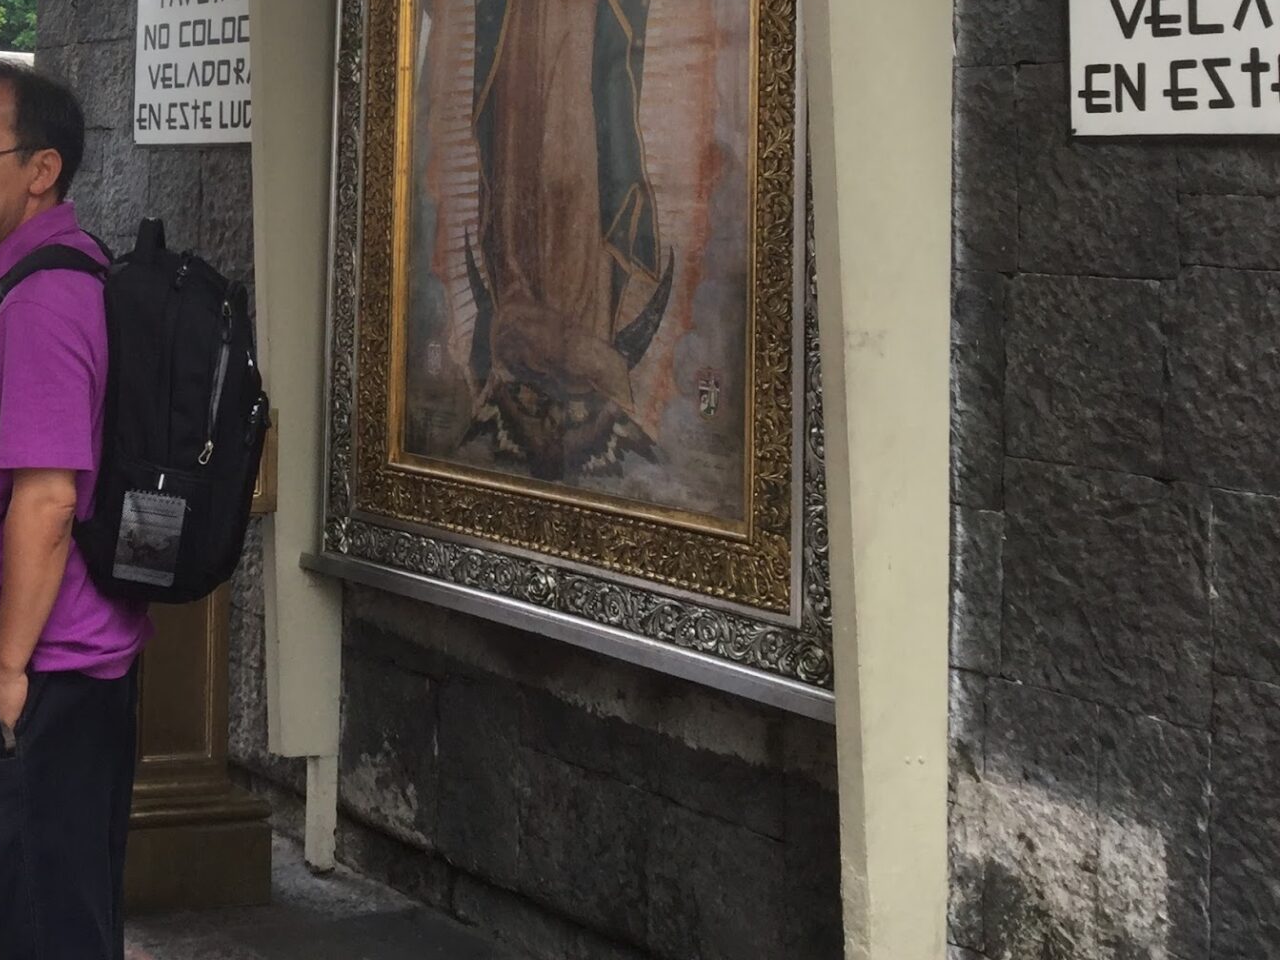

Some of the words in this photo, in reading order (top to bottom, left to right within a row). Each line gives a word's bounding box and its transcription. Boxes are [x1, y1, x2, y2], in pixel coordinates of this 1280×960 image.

[144, 22, 170, 51] NO
[148, 57, 251, 90] VELADOR
[1078, 62, 1147, 114] EN
[1163, 47, 1280, 111] EST
[136, 103, 161, 130] EN
[166, 99, 212, 130] ESTE
